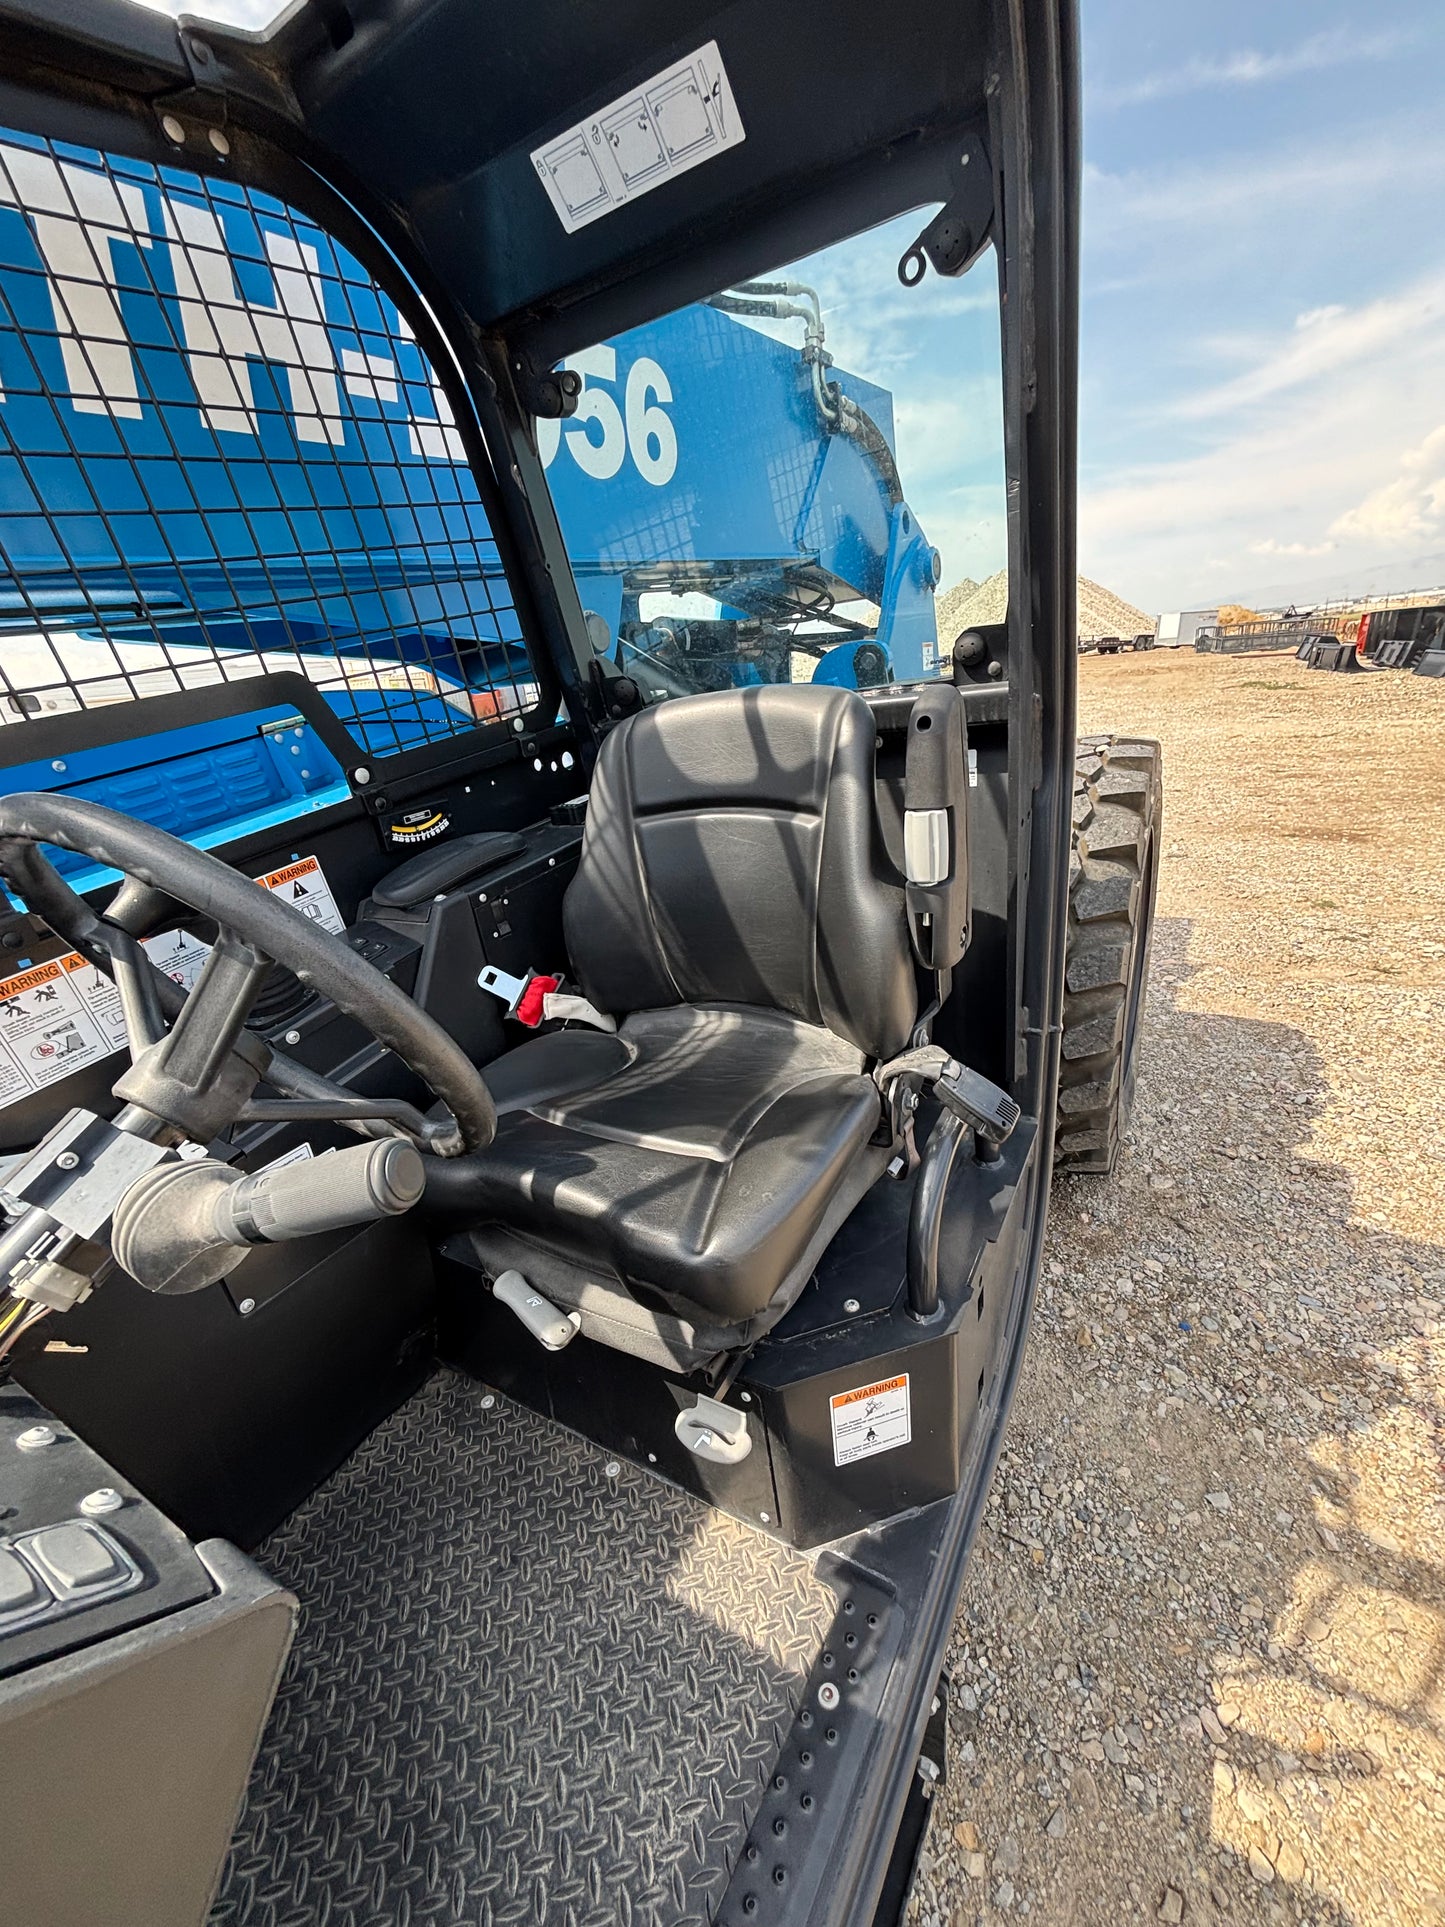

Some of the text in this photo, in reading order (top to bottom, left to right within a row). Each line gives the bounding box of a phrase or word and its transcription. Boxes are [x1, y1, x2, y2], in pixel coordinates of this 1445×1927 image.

[536, 344, 678, 487] 56
[278, 860, 316, 882] WARNING
[0, 965, 60, 997] WARNING
[853, 1380, 899, 1400] WARNING
